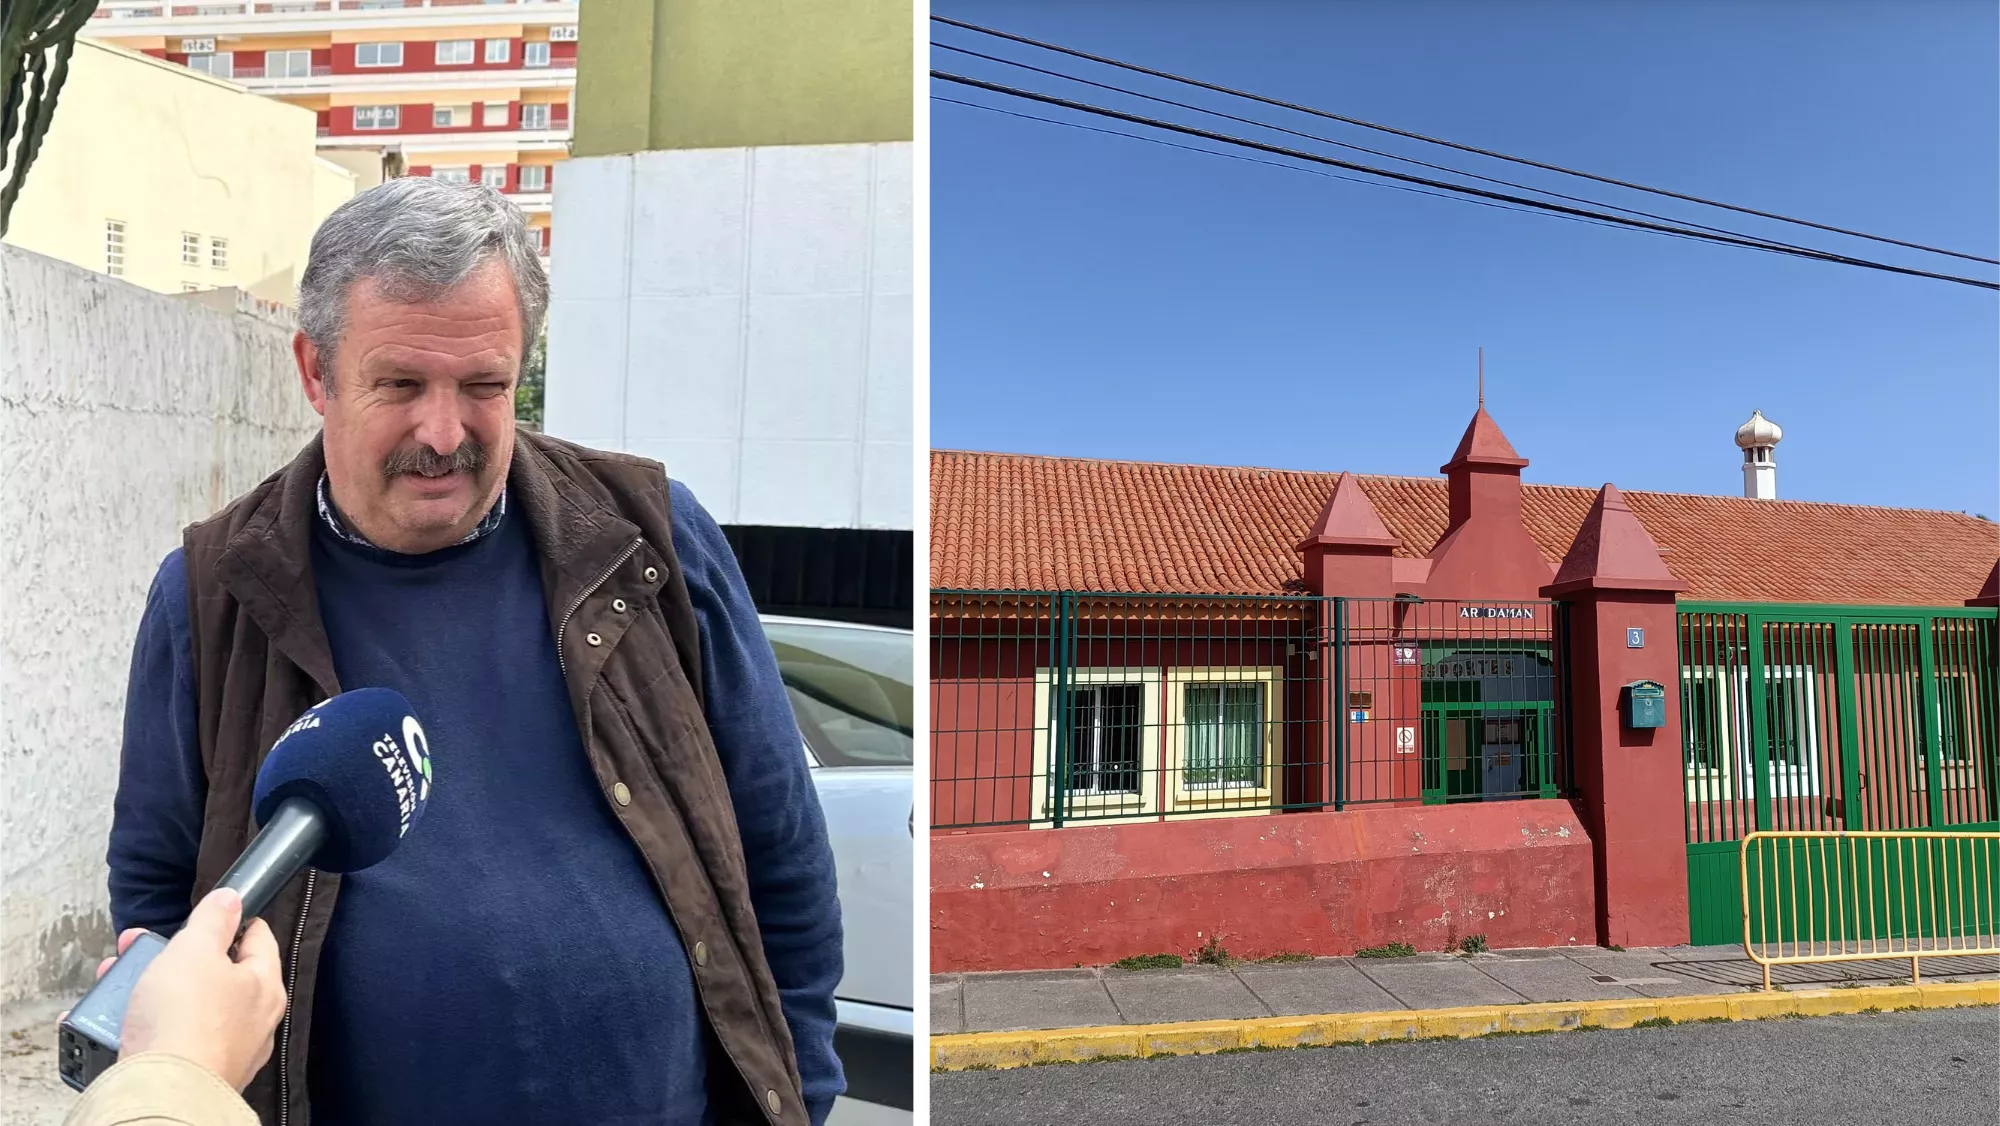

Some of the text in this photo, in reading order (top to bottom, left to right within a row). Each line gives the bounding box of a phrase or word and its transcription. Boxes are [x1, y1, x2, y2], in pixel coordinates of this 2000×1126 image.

[551, 27, 576, 39] ista
[1460, 607, 1533, 619] ARDAMAN
[1631, 631, 1640, 645] 3
[372, 741, 411, 839] CANARIA
